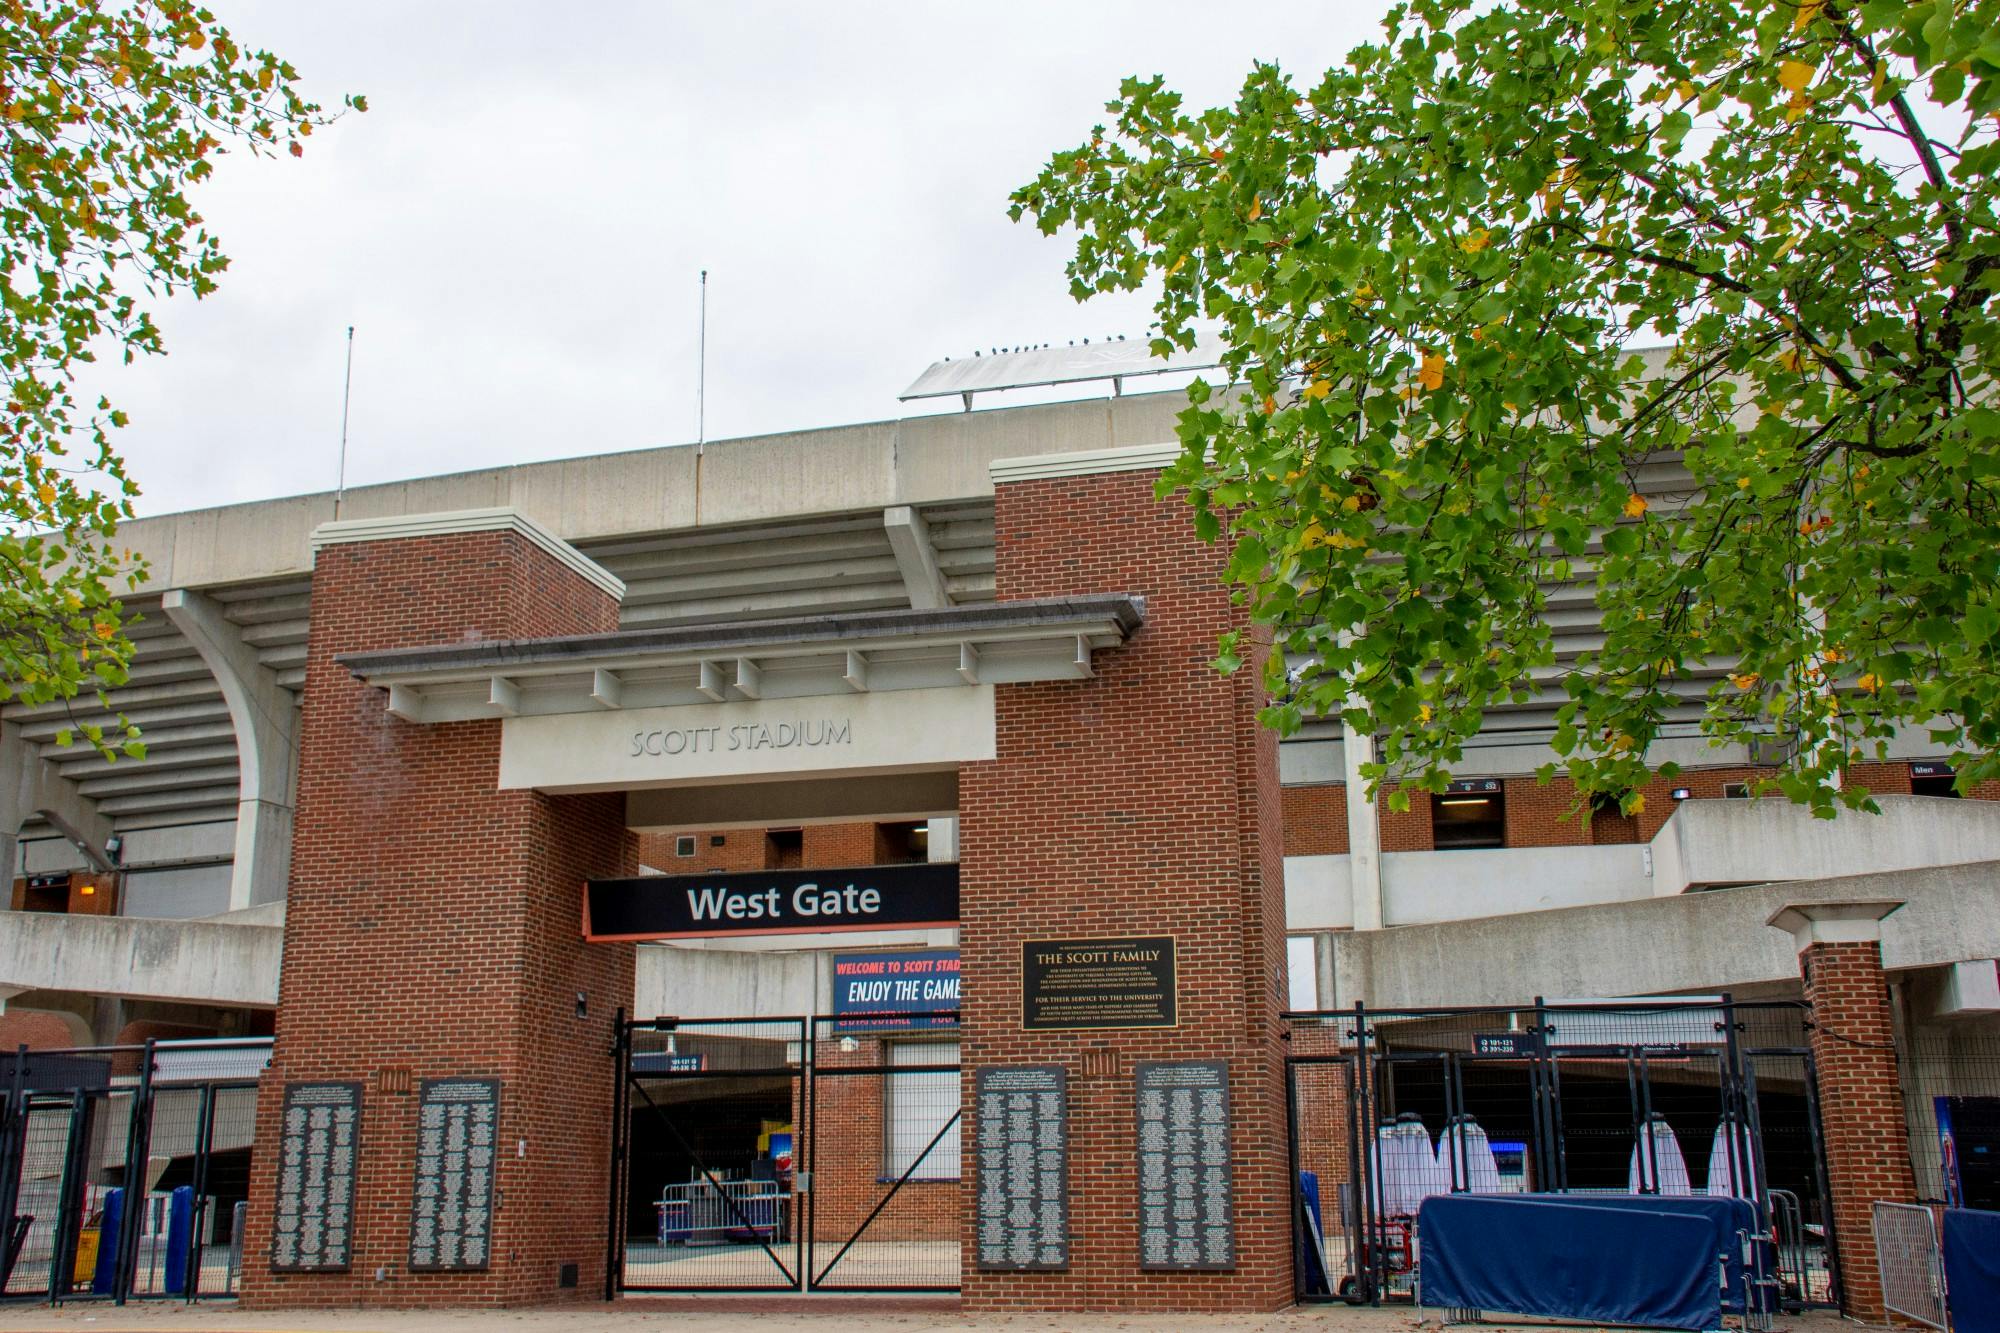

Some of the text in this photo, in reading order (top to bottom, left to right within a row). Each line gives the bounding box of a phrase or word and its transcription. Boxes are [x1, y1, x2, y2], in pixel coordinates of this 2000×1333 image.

[632, 718, 851, 757] SCOTT STADIUM
[687, 884, 881, 920] West Gate
[1036, 950, 1160, 964] THE SCOTT FAMILY
[837, 962, 885, 975] WELCOME
[888, 961, 901, 973] TO
[903, 960, 934, 973] SCOTT
[848, 978, 960, 1002] ENJOY THE GAME
[1124, 993, 1163, 1001] UNIVERSITY
